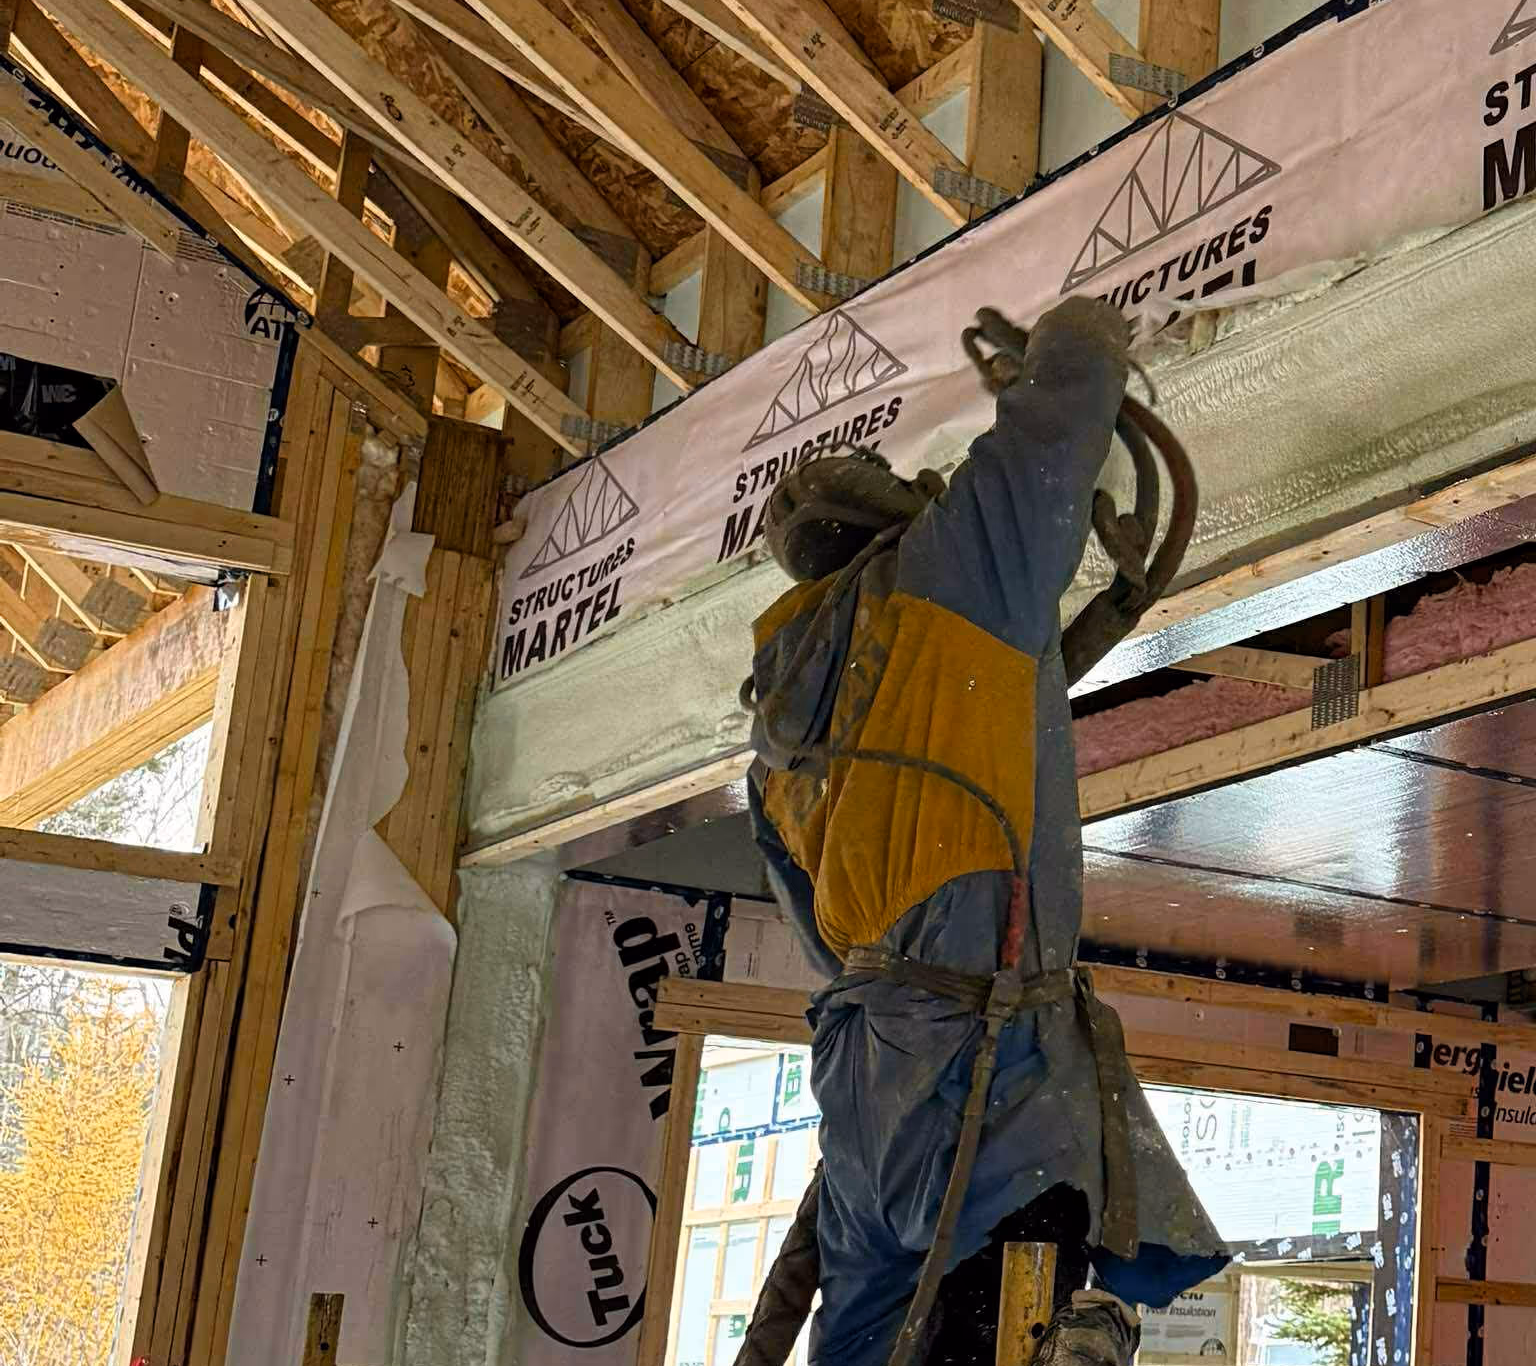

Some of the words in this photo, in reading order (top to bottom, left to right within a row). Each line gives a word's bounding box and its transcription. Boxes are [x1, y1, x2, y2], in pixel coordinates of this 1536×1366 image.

[1096, 204, 1273, 311] UCTURES
[733, 396, 903, 504] STRUCTURES
[501, 578, 625, 680] MARTEL
[509, 537, 635, 627] STRUCTURES
[562, 1187, 630, 1327] Tuck
